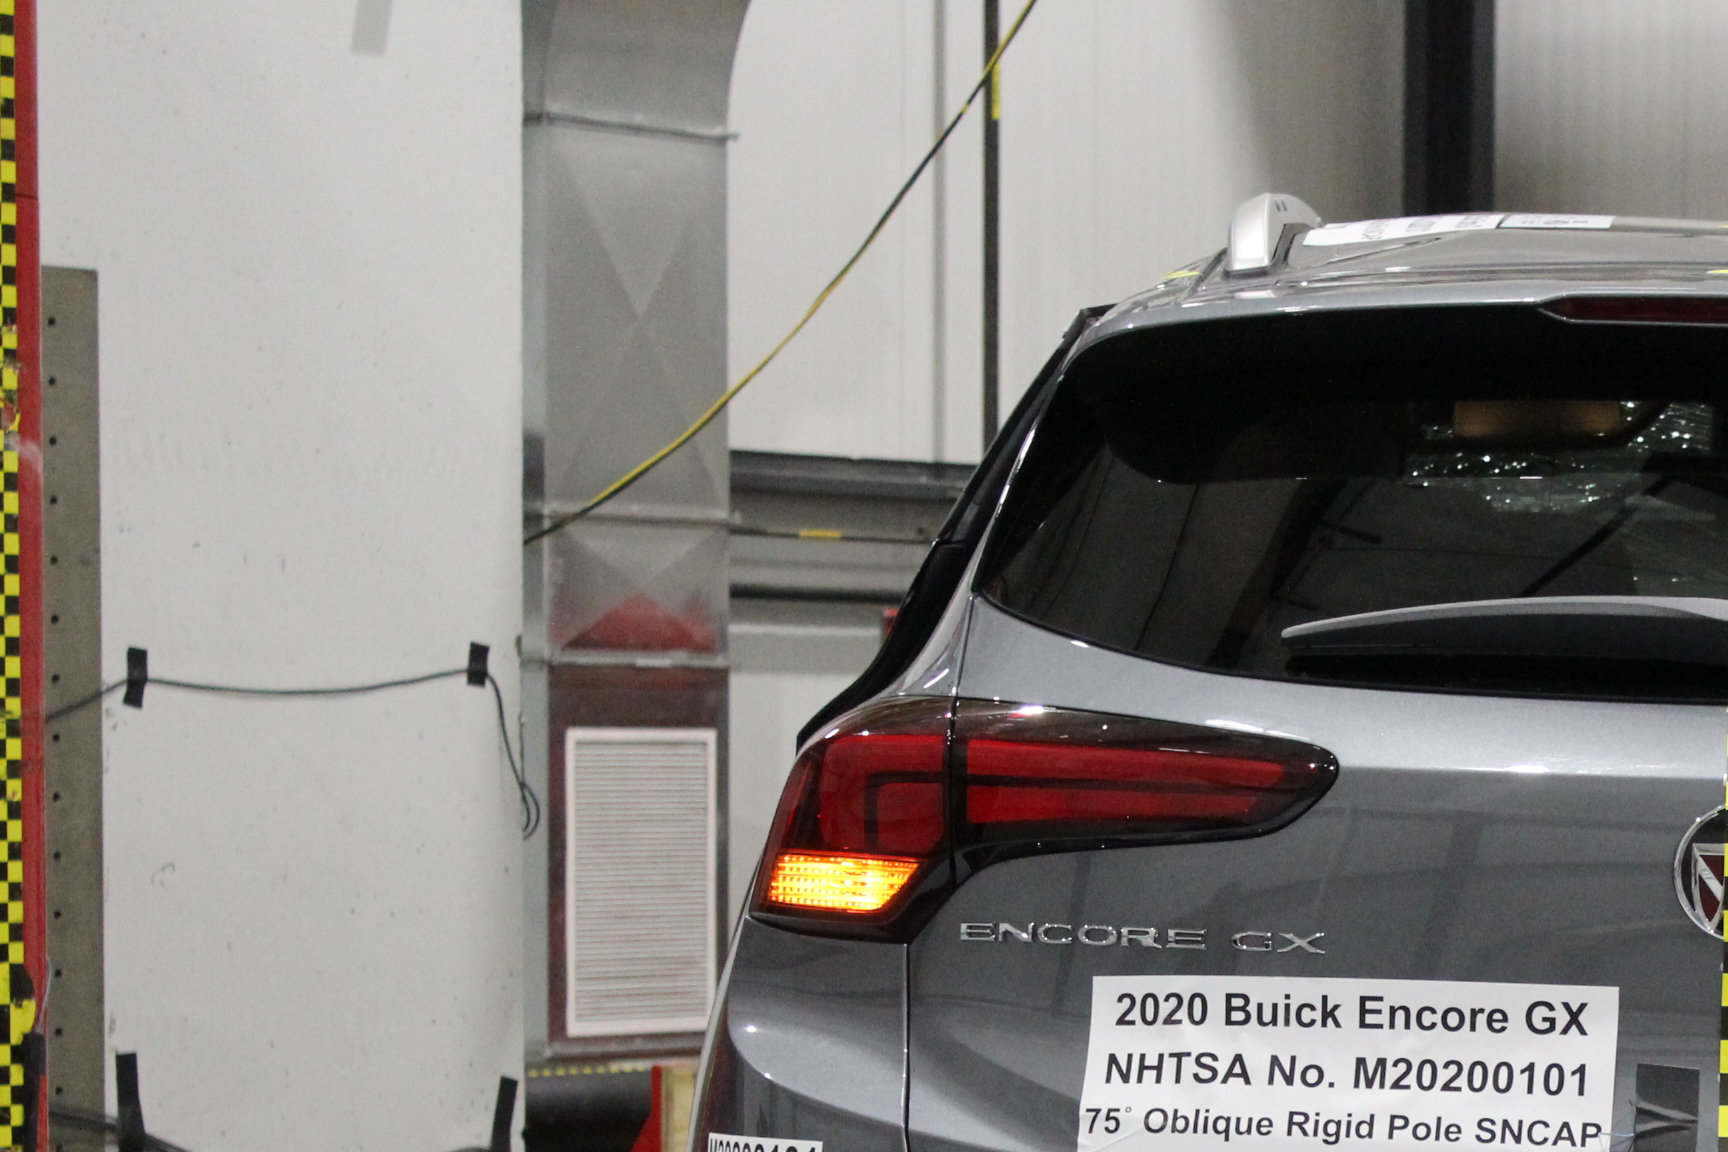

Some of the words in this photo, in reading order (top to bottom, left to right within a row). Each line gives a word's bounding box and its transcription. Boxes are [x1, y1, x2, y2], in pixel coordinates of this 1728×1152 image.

[960, 922, 1207, 950] ENCORE
[1231, 932, 1326, 954] GX
[1115, 992, 1209, 1027] 2020
[1224, 995, 1341, 1029] Buick
[1359, 995, 1509, 1034] Encore
[1525, 1000, 1589, 1037] GX
[1105, 1053, 1252, 1086] NHTSA
[1267, 1057, 1336, 1090] No.
[1354, 1057, 1588, 1097] M20200101
[1085, 1105, 1133, 1135] 75°
[1143, 1108, 1274, 1143] Oblique
[1285, 1110, 1373, 1145] Rigid
[1387, 1113, 1463, 1145] Pole
[1475, 1118, 1603, 1149] SNCAP
